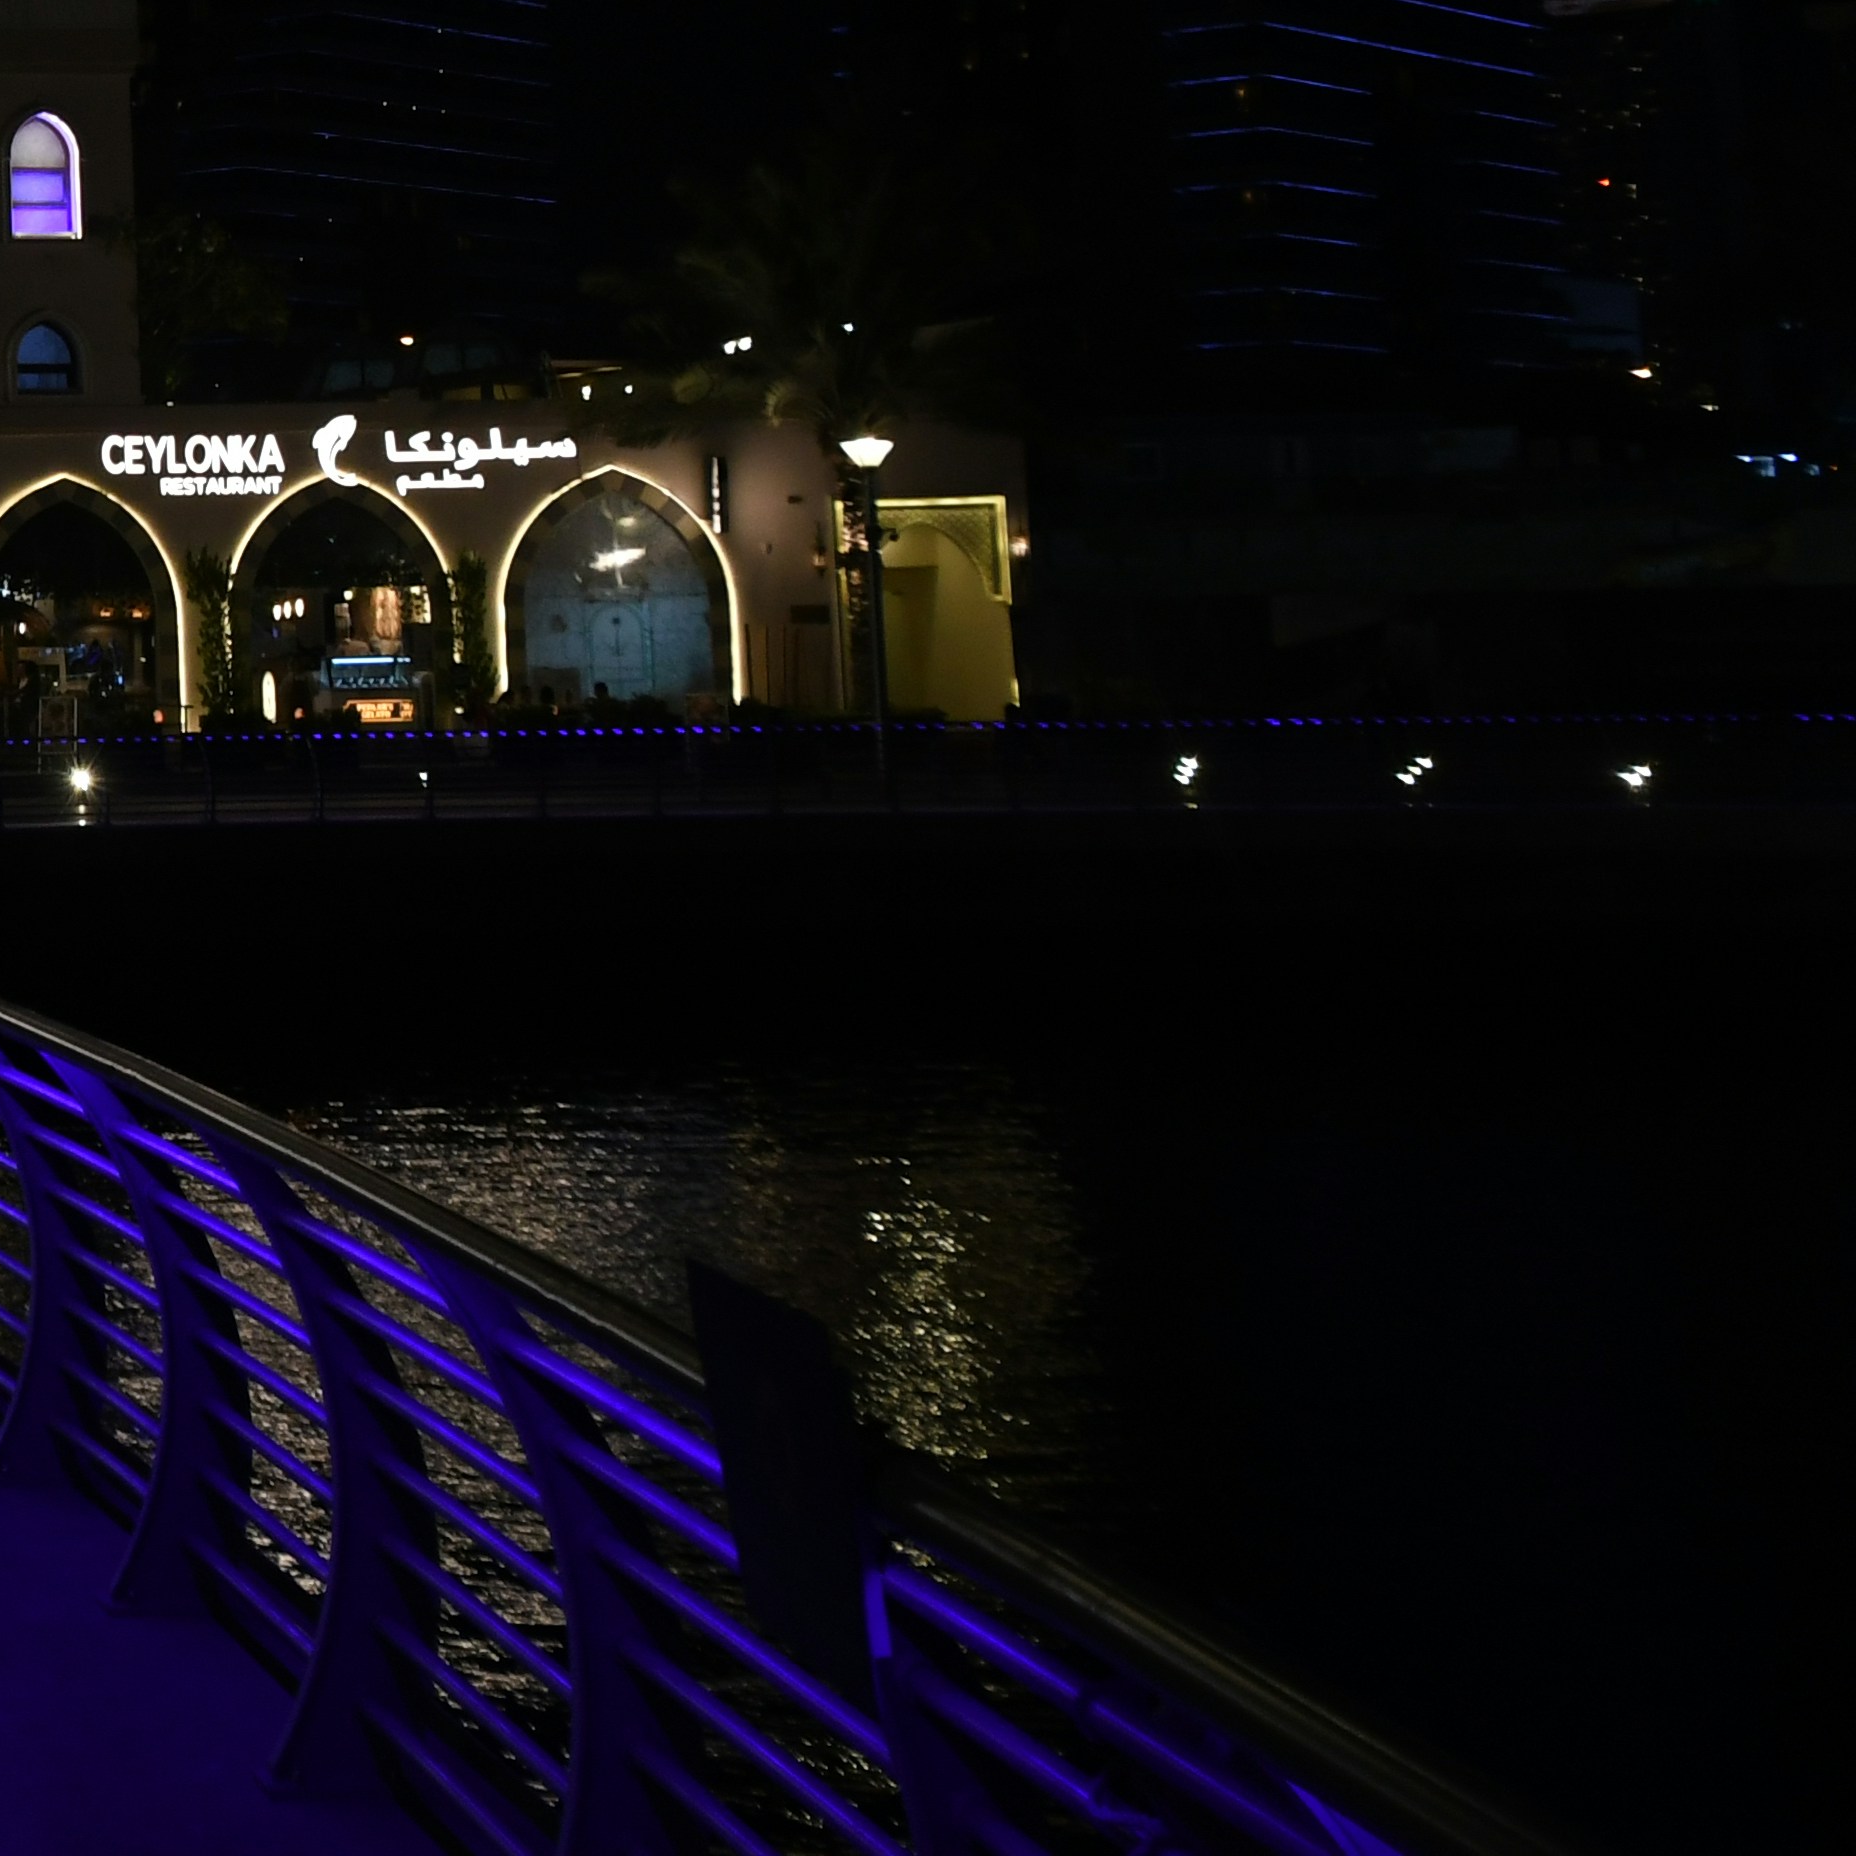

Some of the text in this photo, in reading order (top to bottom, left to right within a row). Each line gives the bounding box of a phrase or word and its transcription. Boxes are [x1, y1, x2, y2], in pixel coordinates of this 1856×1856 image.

[101, 434, 285, 475] CEYLONKA
[384, 427, 577, 471] سيلونكا
[159, 475, 283, 496] RESTAURANT
[395, 468, 485, 497] مطعم
